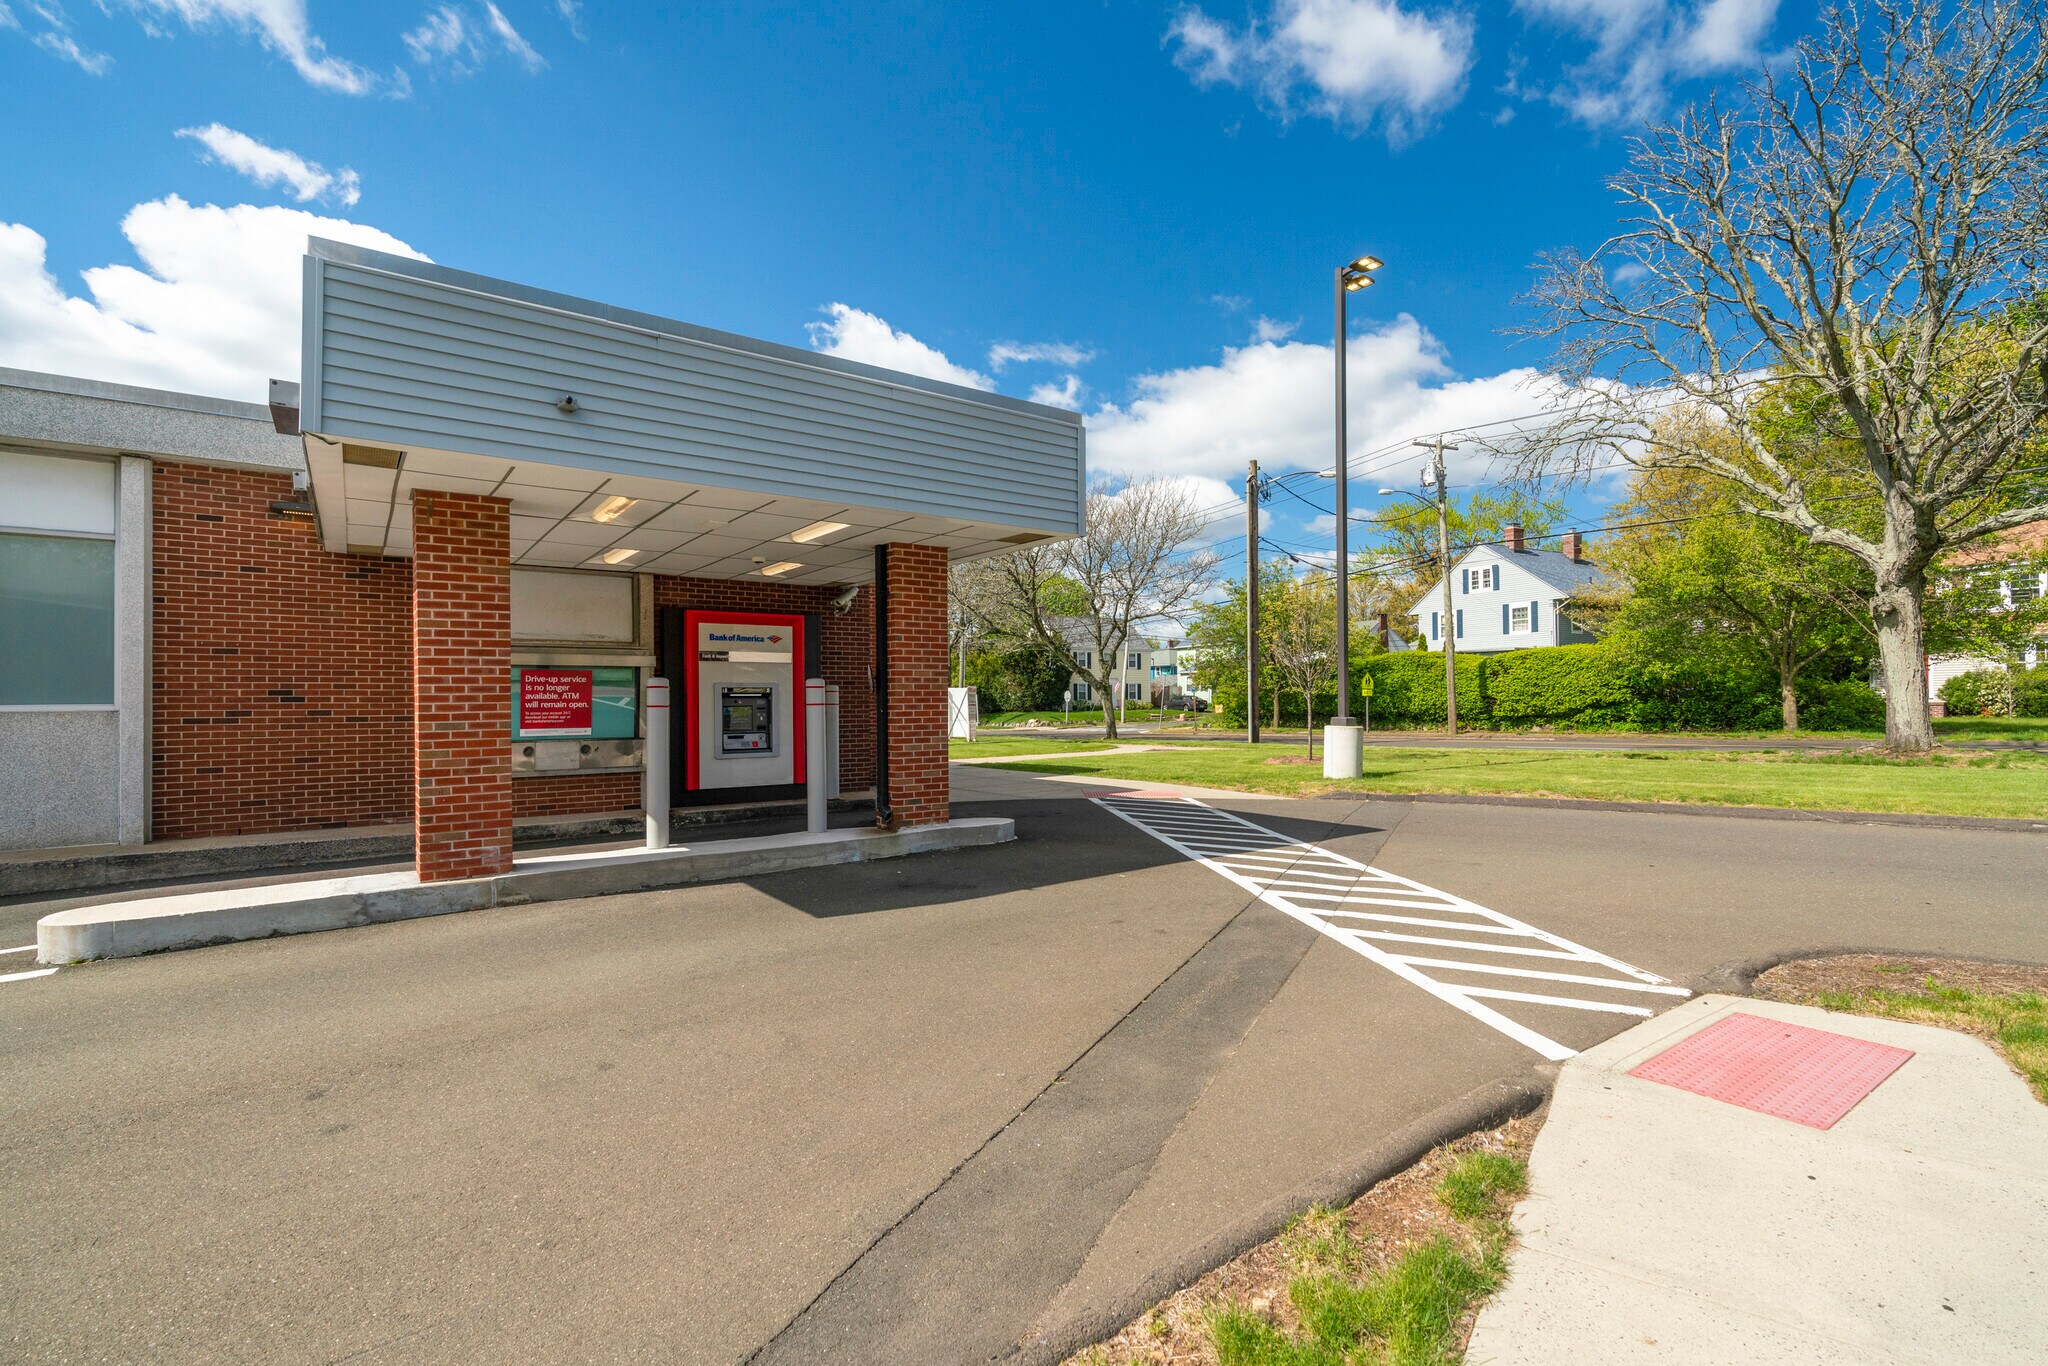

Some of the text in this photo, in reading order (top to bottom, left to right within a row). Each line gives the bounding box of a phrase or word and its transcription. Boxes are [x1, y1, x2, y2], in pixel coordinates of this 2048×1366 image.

[709, 633, 728, 641] Bank
[736, 634, 764, 642] America
[525, 675, 558, 684] Drive-up
[546, 684, 570, 692] longer
